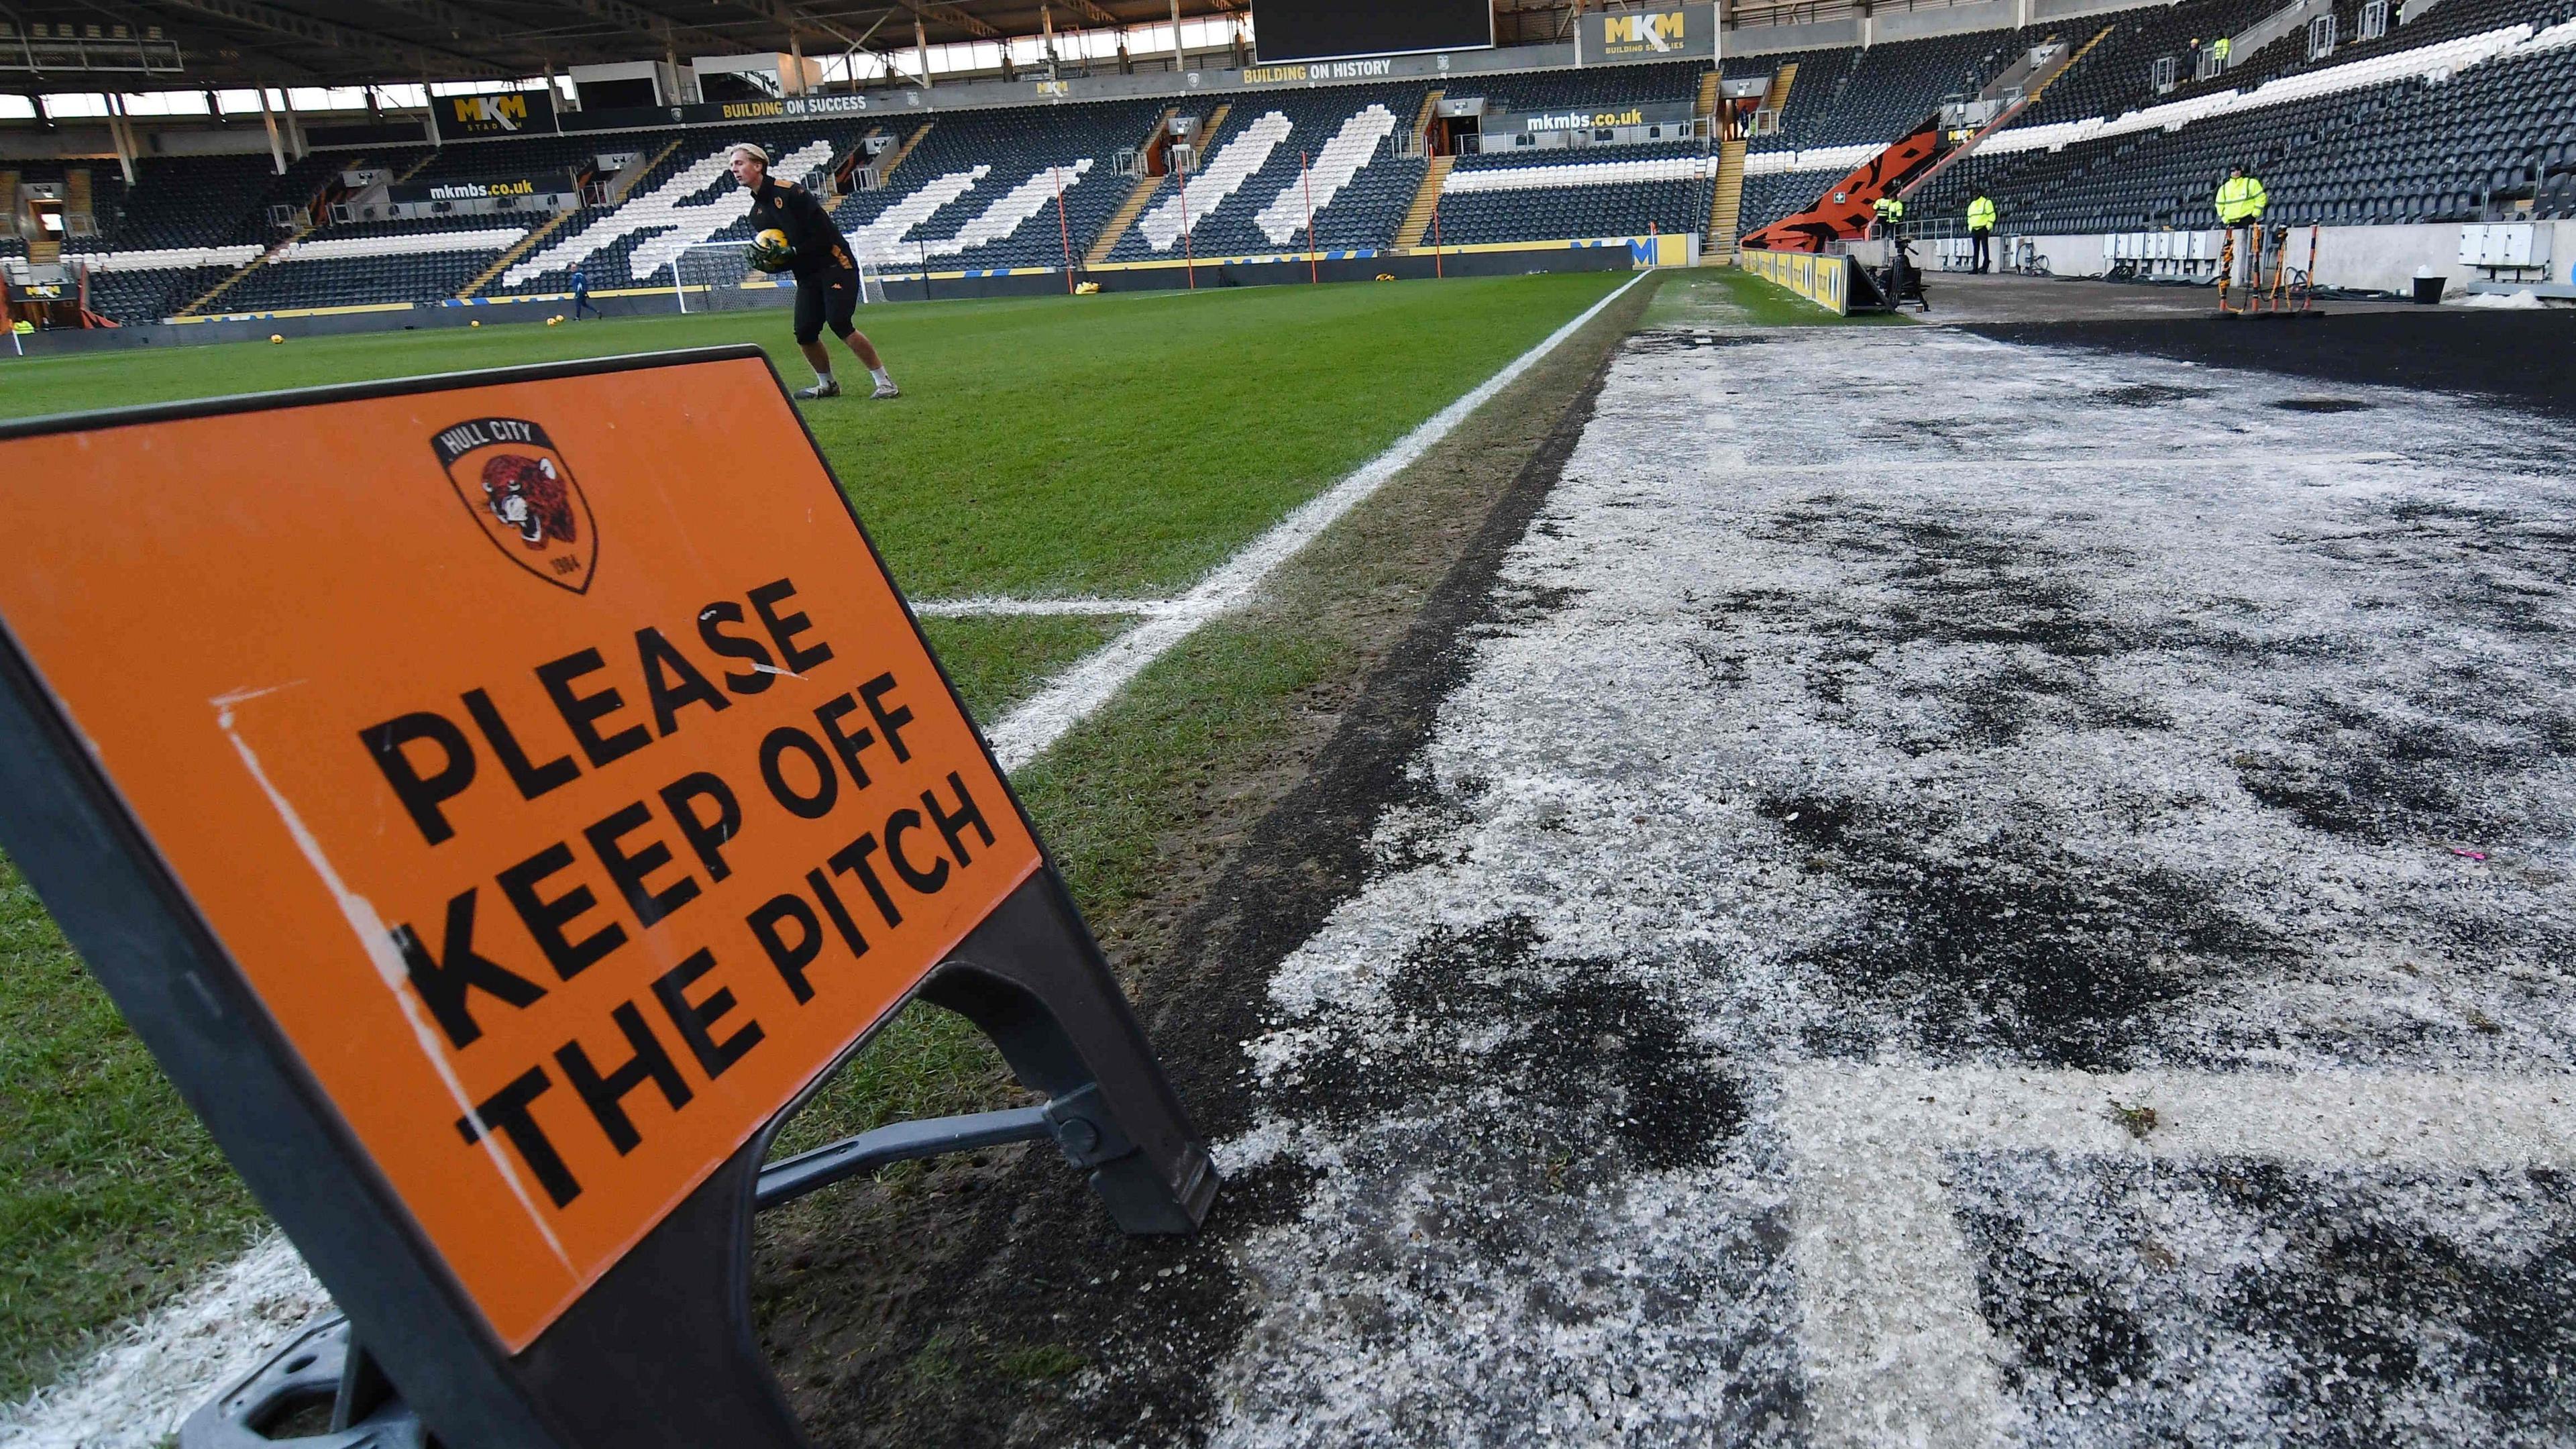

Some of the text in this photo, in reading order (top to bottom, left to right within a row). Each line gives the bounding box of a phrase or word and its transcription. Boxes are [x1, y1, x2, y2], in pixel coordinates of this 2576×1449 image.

[1605, 12, 1684, 52] MKM
[1605, 44, 1644, 54] BUILDING
[1243, 60, 1391, 84] BUILDING ON HISTORY
[1036, 81, 1069, 97] MKM
[453, 95, 527, 131] MKM
[722, 95, 867, 118] BUILDING ON SUCCESS
[1527, 107, 1642, 131] mkmbs.co.uk
[430, 179, 533, 199] mkmbs.co.uk
[440, 420, 533, 455] HULL CITY
[358, 578, 835, 847] PLEASE
[389, 672, 914, 1051] KEEP OFF
[454, 770, 996, 1210] THE PITCH
